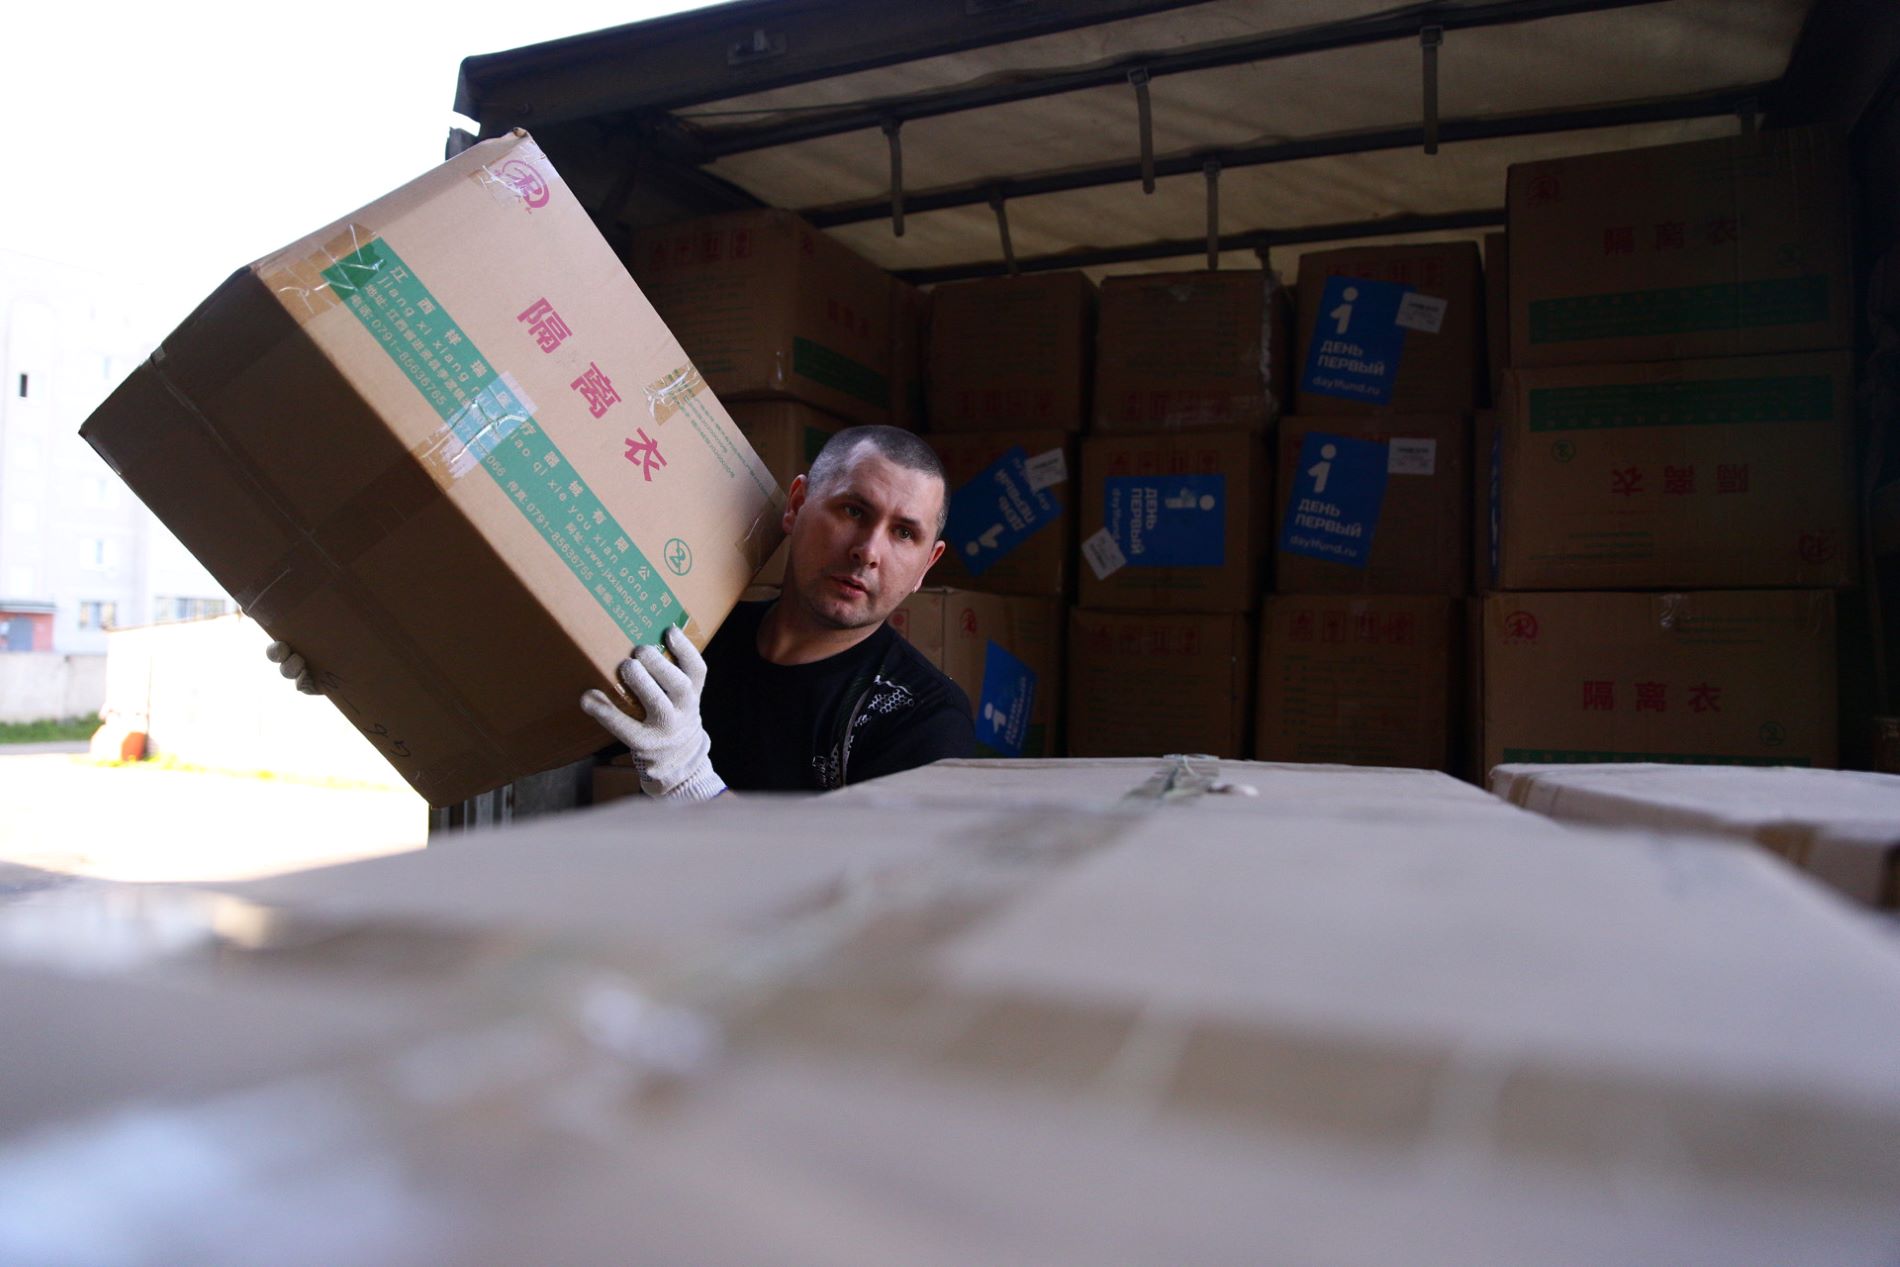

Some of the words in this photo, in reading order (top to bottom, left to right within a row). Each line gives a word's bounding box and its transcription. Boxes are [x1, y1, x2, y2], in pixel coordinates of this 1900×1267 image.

[1316, 353, 1386, 377] ПЕРВЫЙ
[1320, 340, 1364, 357] ДЕНЬ
[516, 296, 668, 482] 隔离衣
[376, 273, 417, 318] jiang
[430, 337, 472, 384] xiang
[565, 503, 594, 533] you
[590, 531, 621, 565] xian
[615, 565, 651, 603] gong
[1130, 487, 1146, 555] ПЕРВЫЙ
[1144, 487, 1158, 531] ДЕНЬ
[1297, 498, 1341, 518] ДЕНЬ
[1294, 513, 1364, 539] ПЕРВЫЙ
[1583, 680, 1723, 714] 隔离衣
